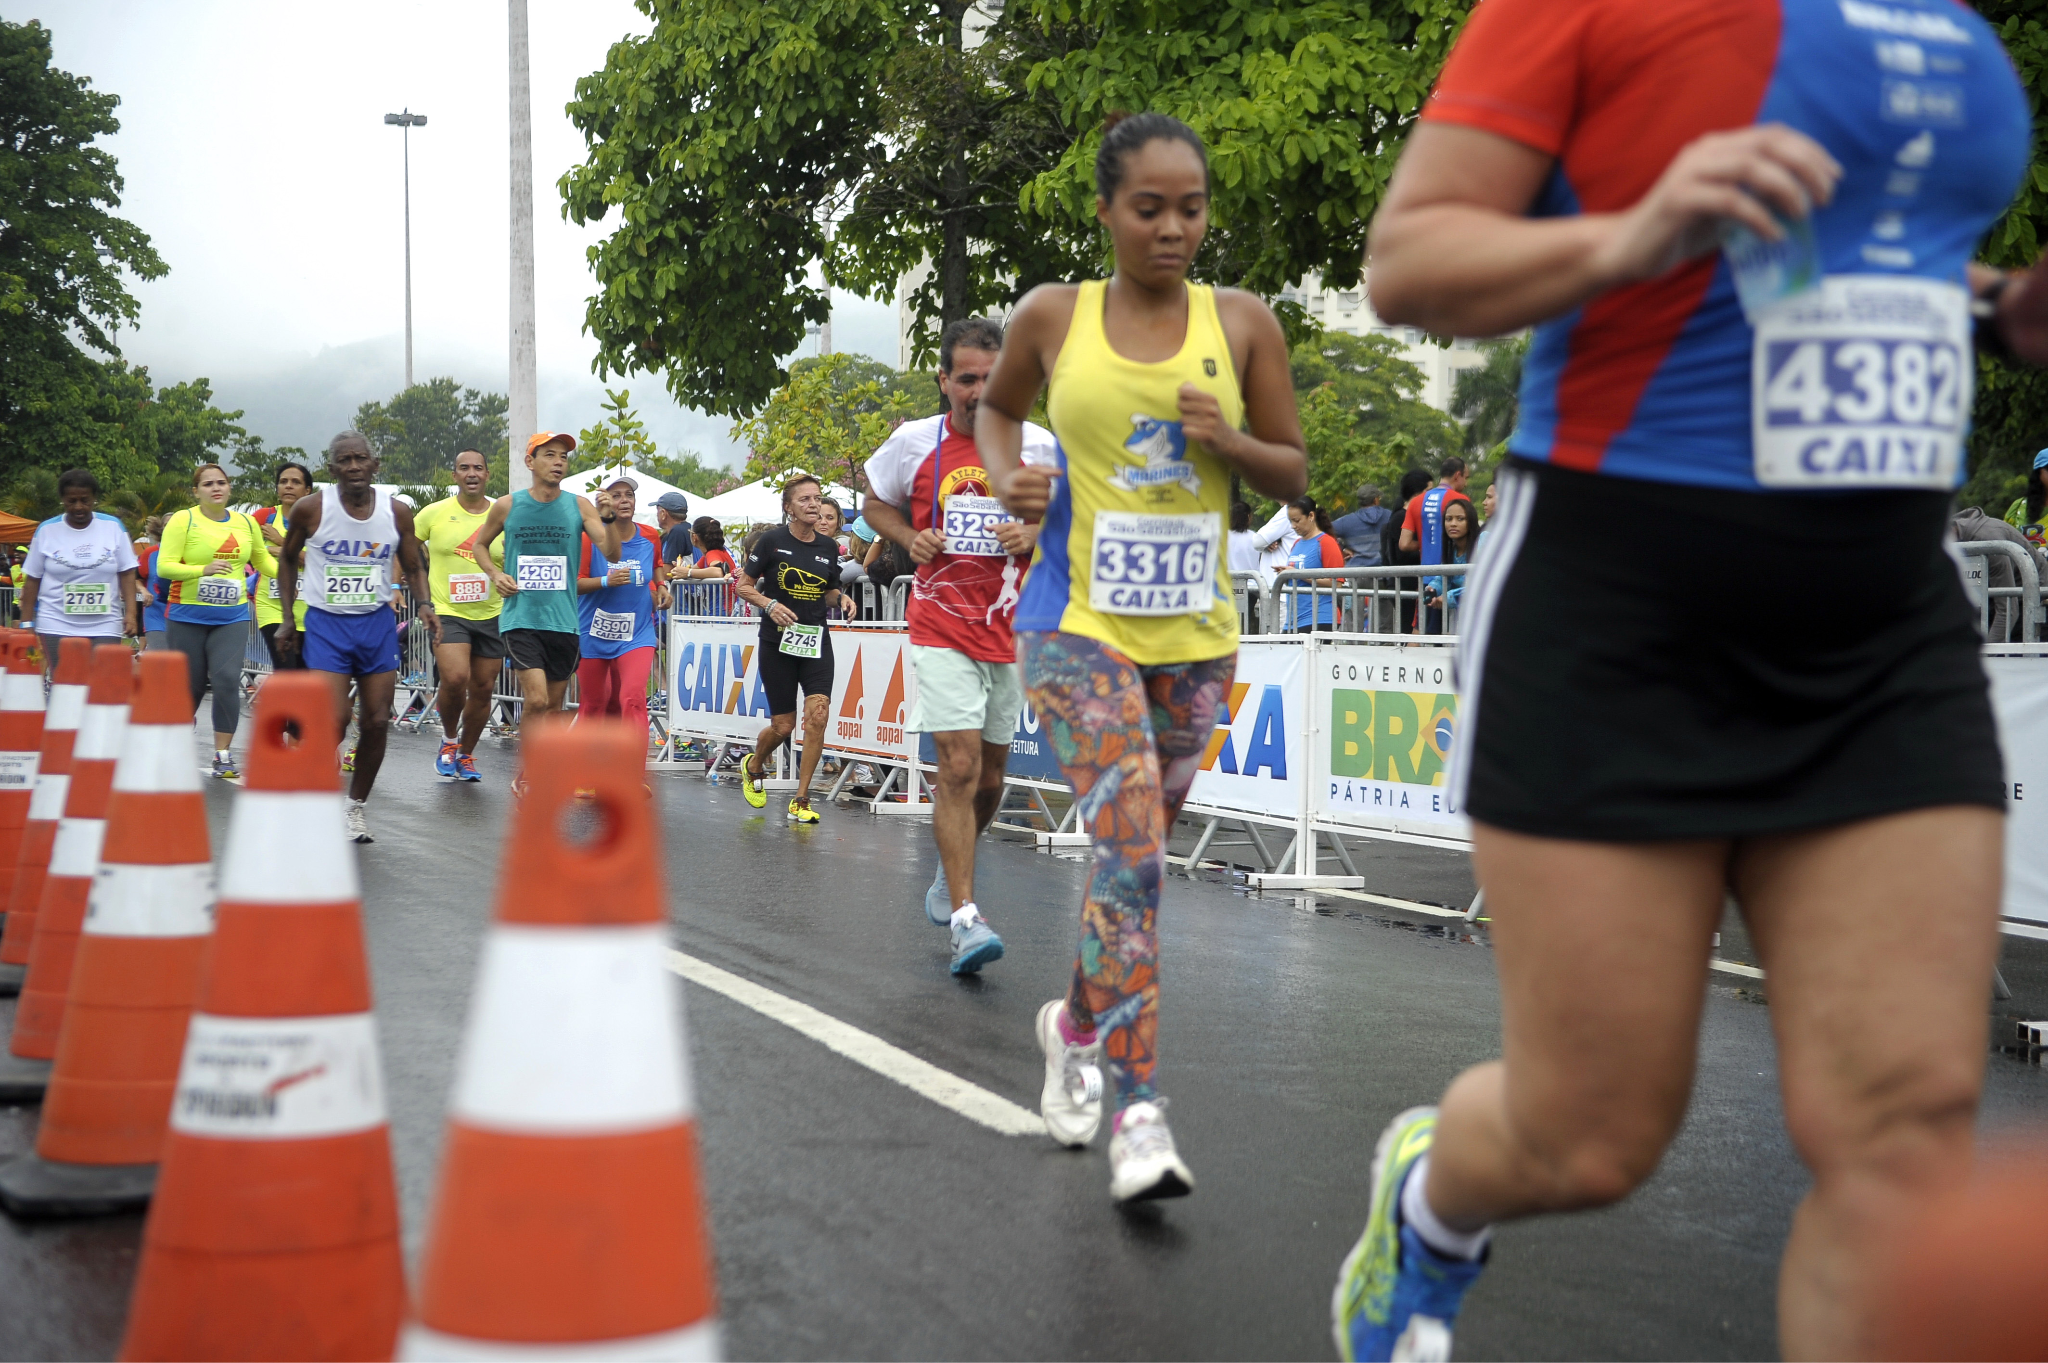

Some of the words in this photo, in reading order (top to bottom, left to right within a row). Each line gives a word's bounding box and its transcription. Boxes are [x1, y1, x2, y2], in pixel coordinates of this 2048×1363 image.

[1766, 341, 1958, 425] 4382
[1127, 465, 1190, 483] MARINES
[321, 540, 392, 560] CAIXA
[453, 549, 475, 559] app
[954, 540, 1006, 555] CAIXA
[1097, 541, 1206, 583] 3316
[519, 565, 560, 580] 4260
[199, 585, 237, 599] 3918
[327, 577, 374, 593] 2670
[455, 582, 482, 594] 888
[524, 581, 556, 589] CAIXA
[65, 593, 105, 605] 2787
[333, 594, 371, 603] CAIXA
[454, 594, 481, 602] CAIXA
[1109, 589, 1188, 608] CAIXA
[70, 605, 102, 613] CAIXA
[593, 617, 630, 633] 3590
[595, 630, 623, 640] CAIXA
[784, 631, 817, 648] 2745
[785, 645, 813, 656] CAIXA
[1332, 664, 1443, 684] GOVERNO
[838, 721, 863, 740] appai
[877, 725, 903, 746] appai
[1331, 781, 1409, 809] PÁTRIA
